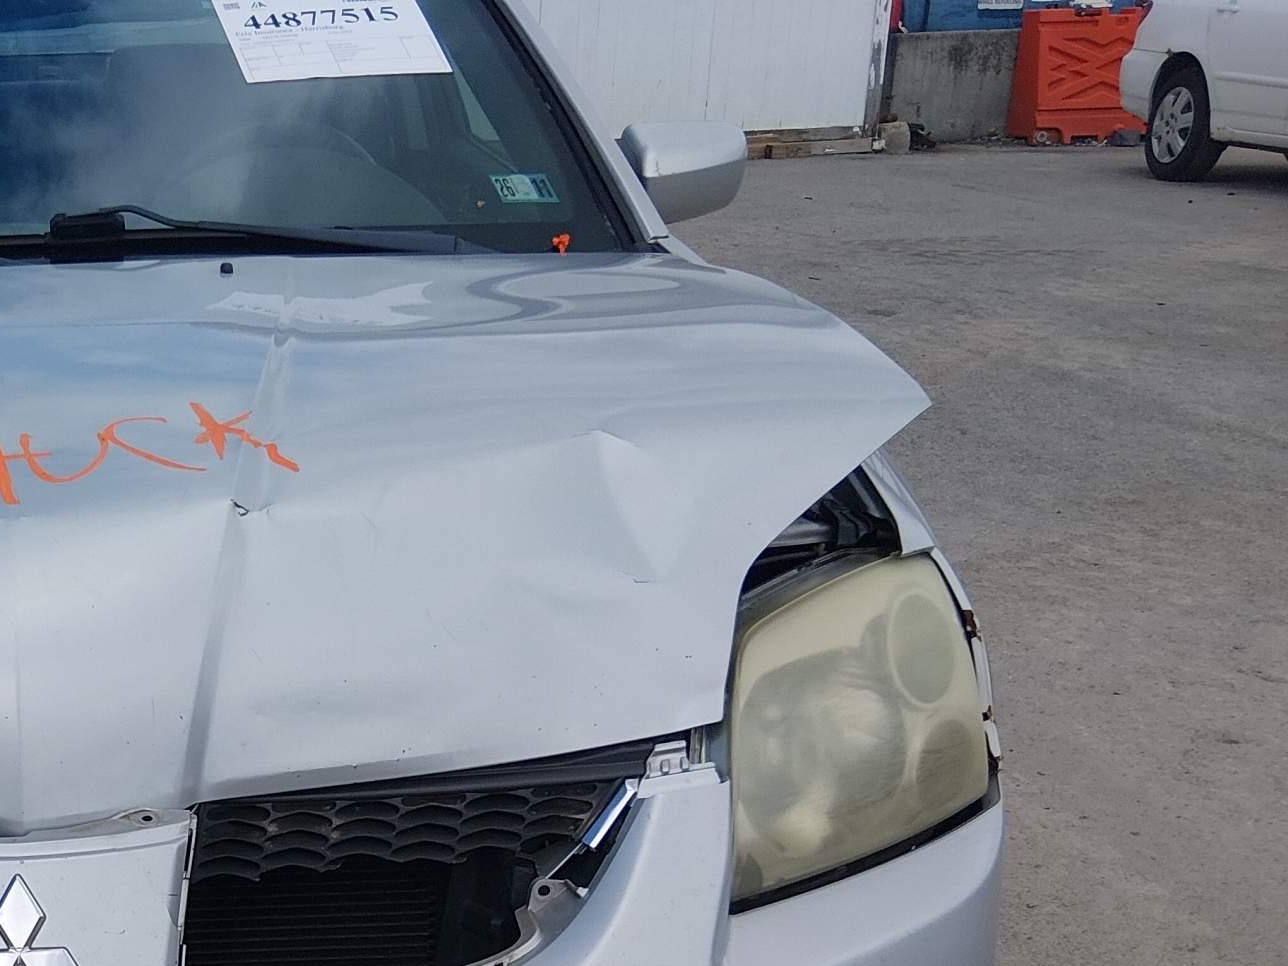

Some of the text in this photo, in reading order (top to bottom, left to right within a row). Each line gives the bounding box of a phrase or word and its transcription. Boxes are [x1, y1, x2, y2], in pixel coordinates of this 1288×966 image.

[244, 6, 398, 30] 44877515
[494, 177, 553, 198] 26 11
